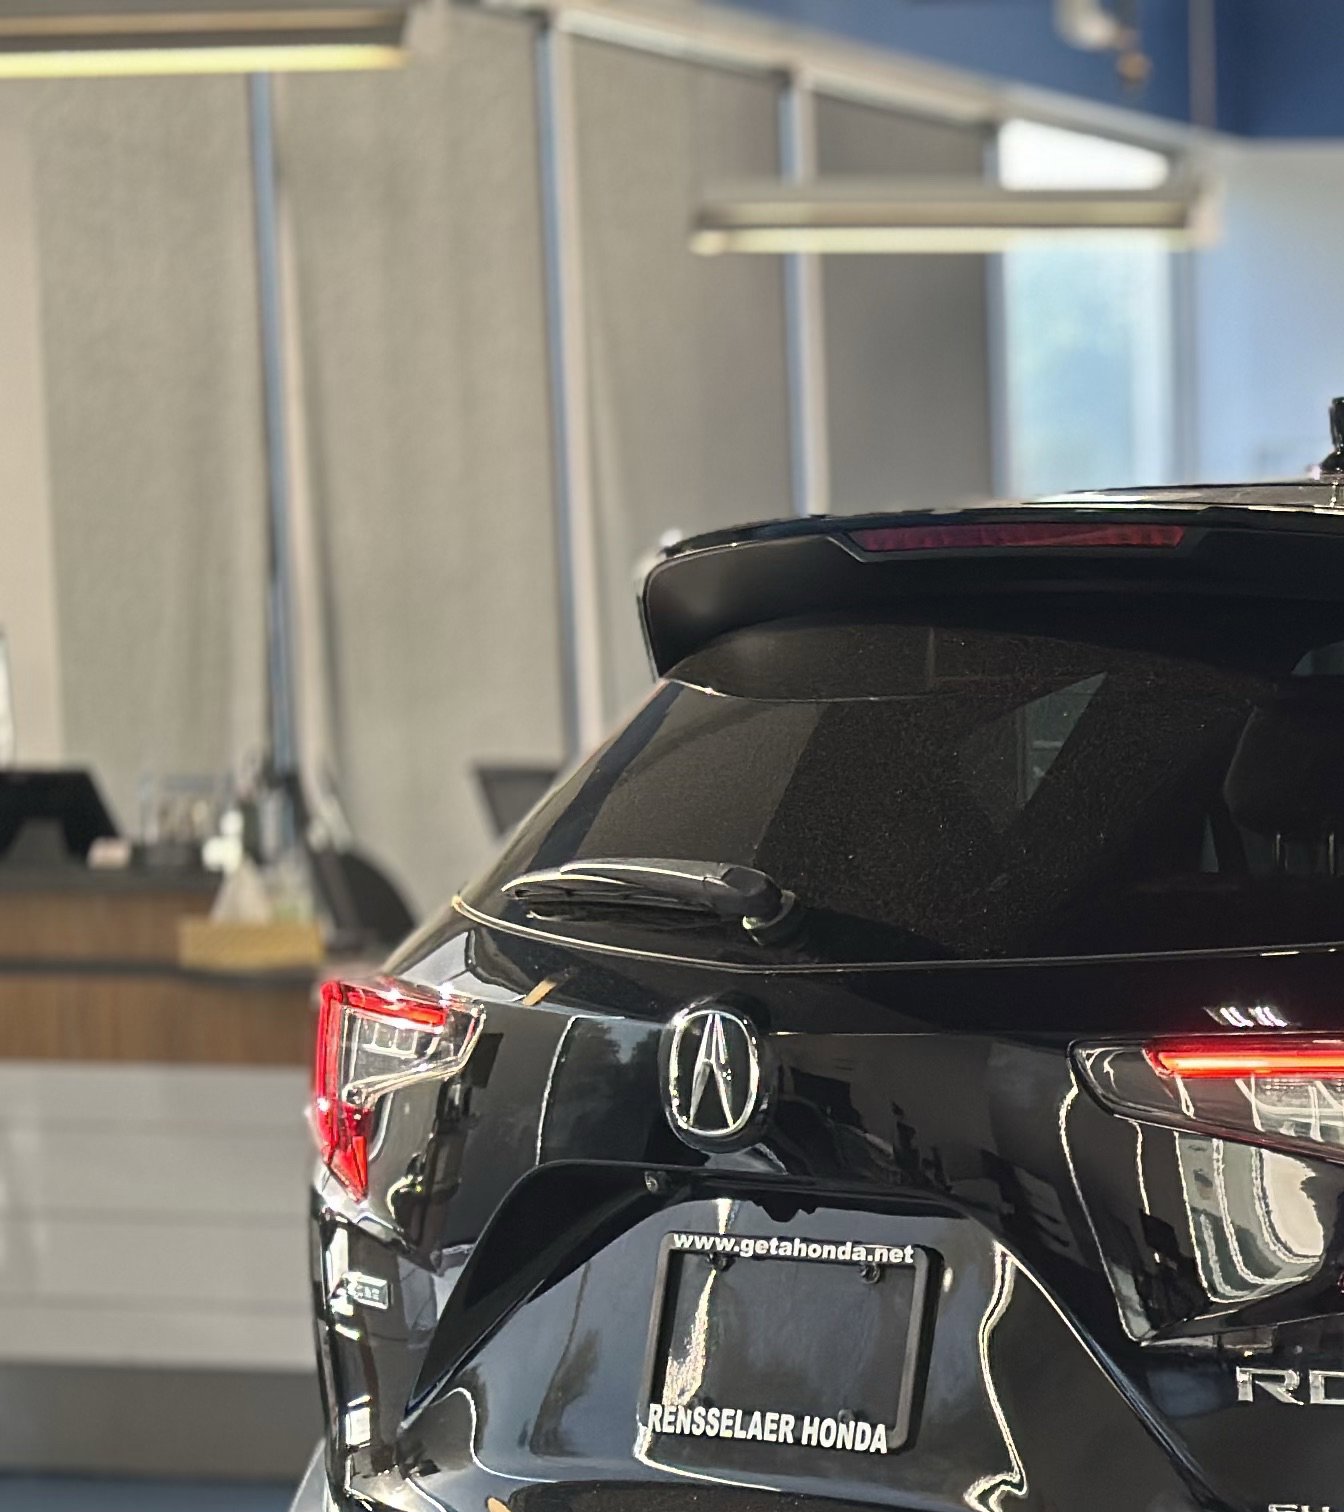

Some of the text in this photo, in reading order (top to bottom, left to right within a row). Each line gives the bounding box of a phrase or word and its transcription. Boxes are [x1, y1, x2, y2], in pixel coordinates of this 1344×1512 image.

[673, 1233, 914, 1263] www.getahonda.net
[650, 1404, 888, 1453] RENSSELAER HONDA
